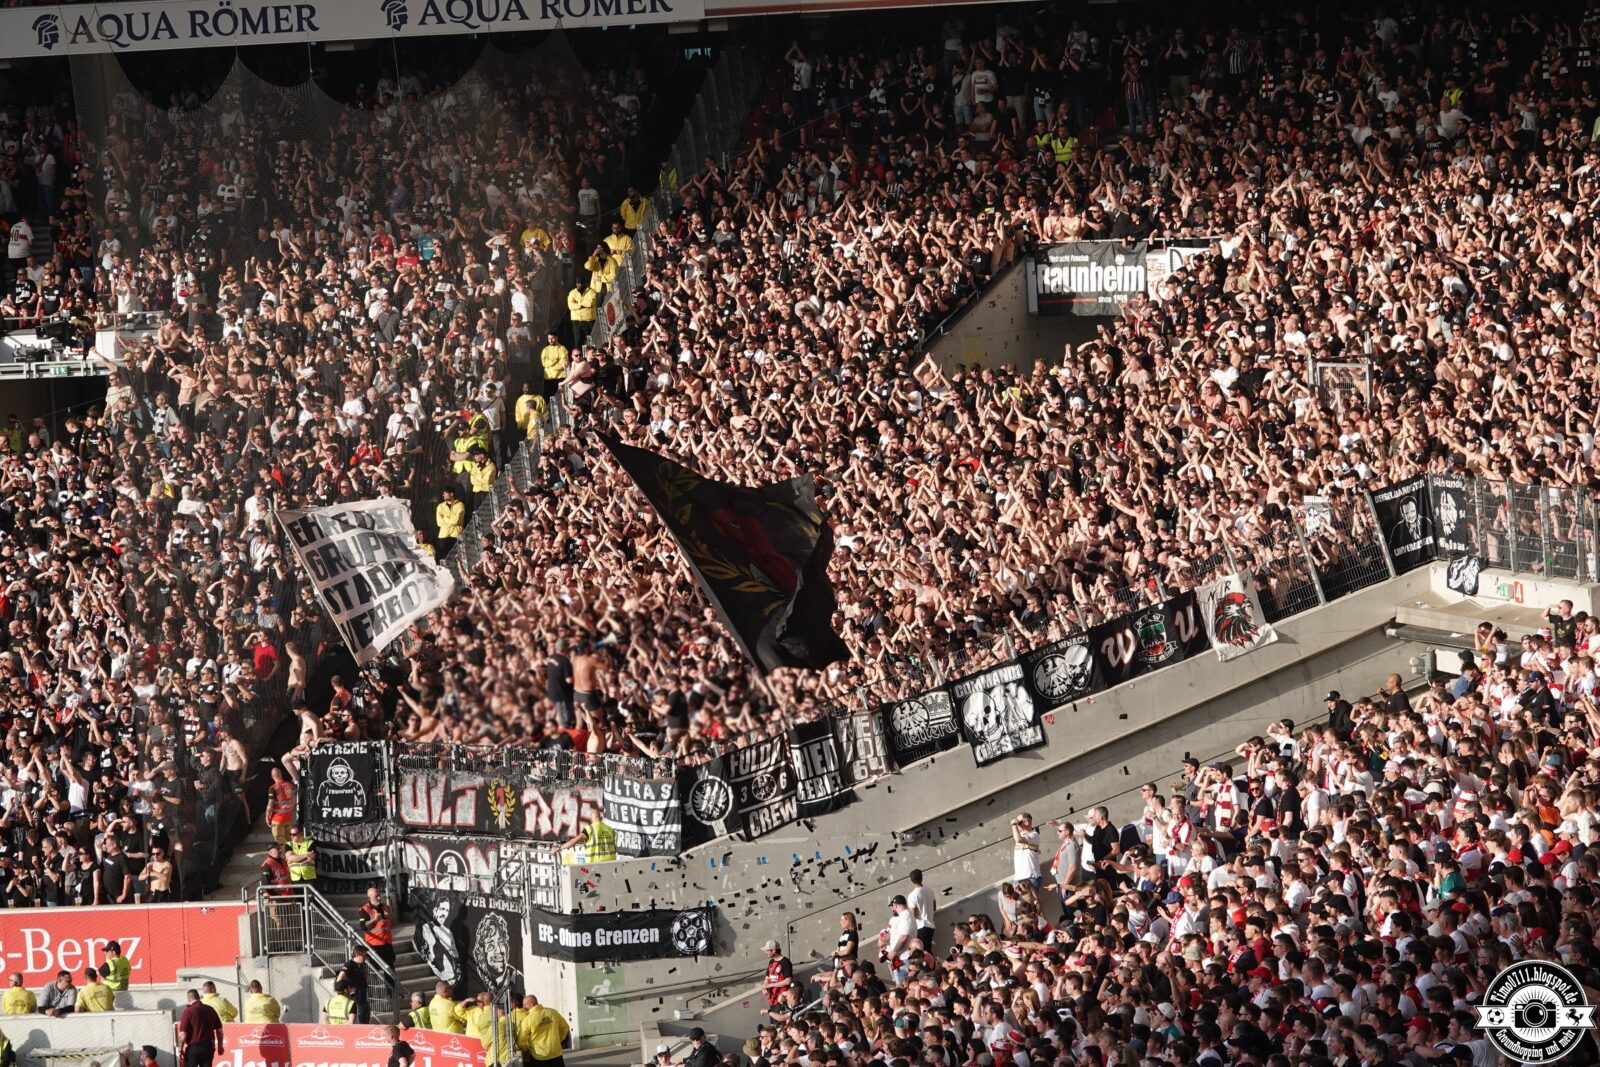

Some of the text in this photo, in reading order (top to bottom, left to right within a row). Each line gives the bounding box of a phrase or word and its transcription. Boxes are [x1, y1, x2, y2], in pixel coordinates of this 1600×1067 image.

[69, 1, 320, 48] AQUA RÖMER
[417, 0, 538, 29] AQUA
[1037, 261, 1145, 294] Raunheim
[954, 663, 1025, 699] COMMANDO
[730, 734, 782, 778] FULDA
[853, 756, 887, 781] 64
[604, 775, 673, 801] ULTRAS
[740, 770, 788, 803] 3 6
[321, 806, 363, 818] FANS
[609, 802, 665, 826] NEVER
[749, 795, 798, 838] CREW
[465, 894, 487, 908] FÜR
[595, 927, 660, 947] Grenzen
